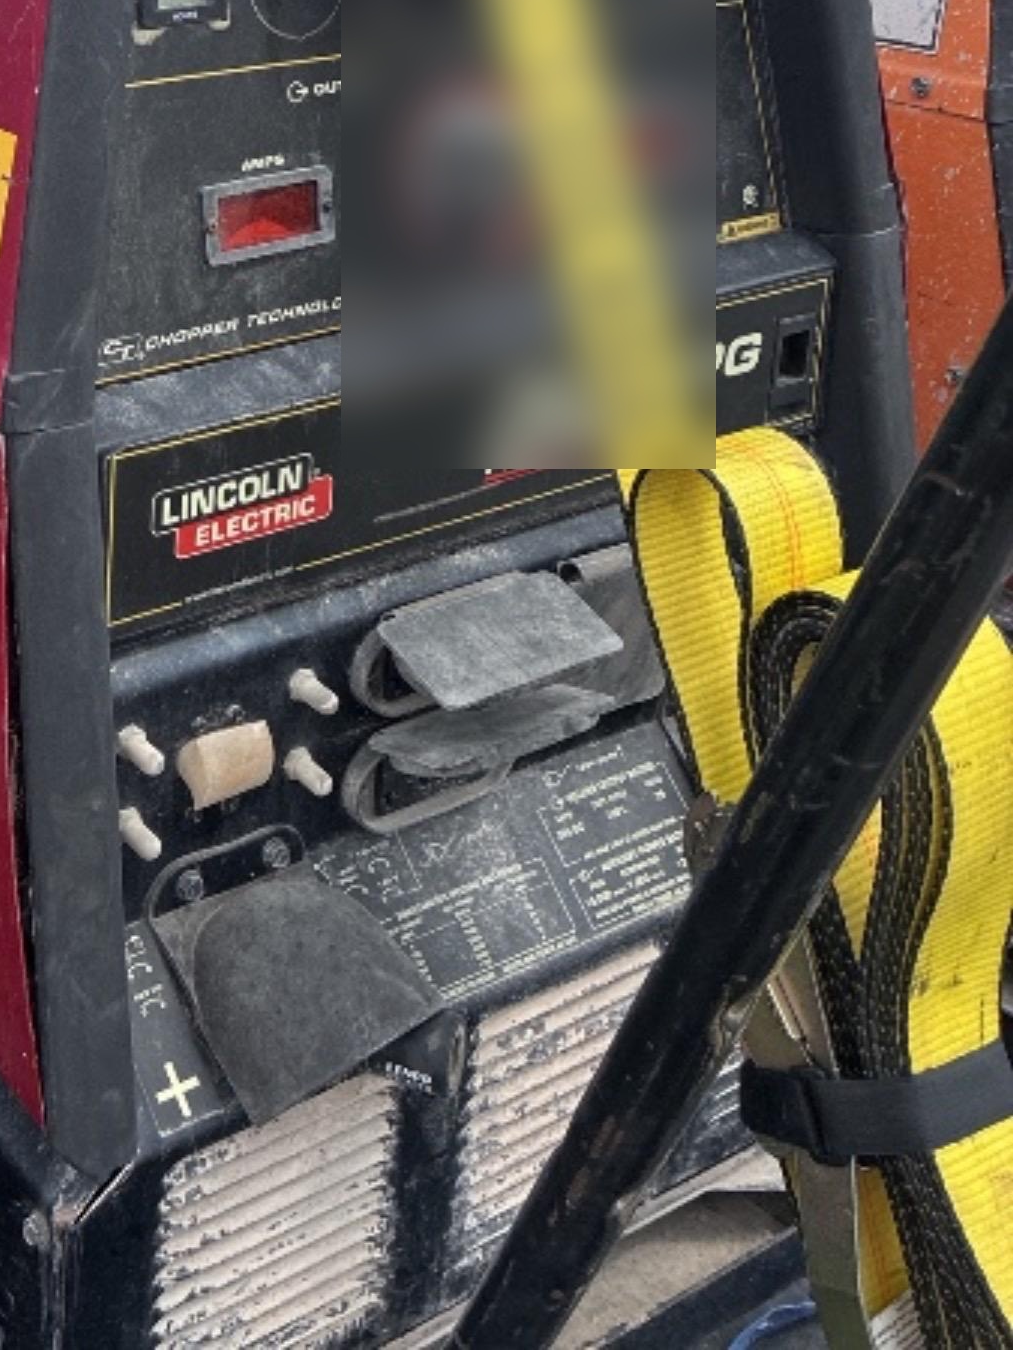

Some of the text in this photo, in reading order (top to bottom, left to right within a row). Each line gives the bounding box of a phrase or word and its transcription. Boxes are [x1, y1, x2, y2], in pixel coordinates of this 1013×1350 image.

[145, 317, 240, 351] CHOPPER
[715, 332, 762, 376] G
[161, 462, 304, 526] LINCOLN
[205, 496, 316, 548] ELECTRIC
